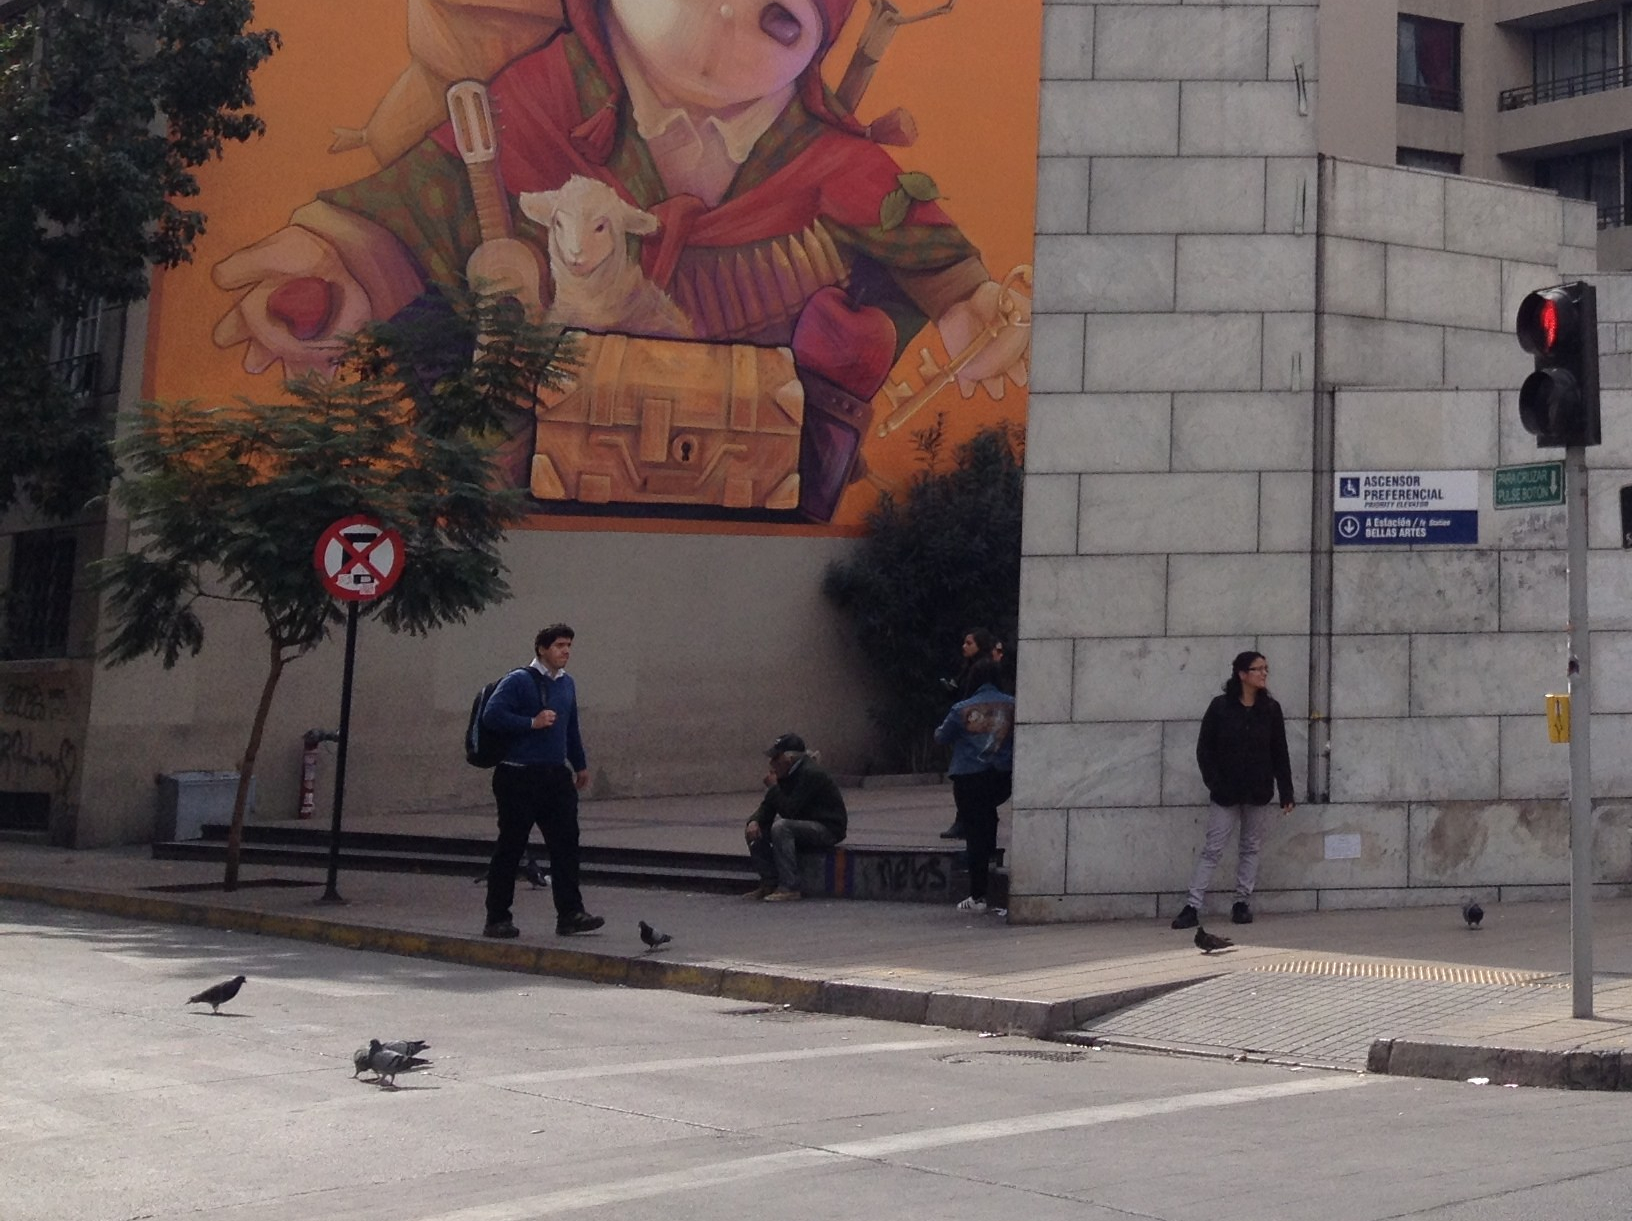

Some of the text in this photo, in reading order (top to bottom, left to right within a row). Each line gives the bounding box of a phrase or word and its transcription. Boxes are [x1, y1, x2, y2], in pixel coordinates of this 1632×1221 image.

[1364, 476, 1421, 487] ASCENSOR
[1364, 488, 1444, 501] PREFERENCIAL
[1365, 517, 1372, 528] A
[1374, 516, 1411, 528] Estación
[1365, 527, 1427, 538] BELLAS ARTES
